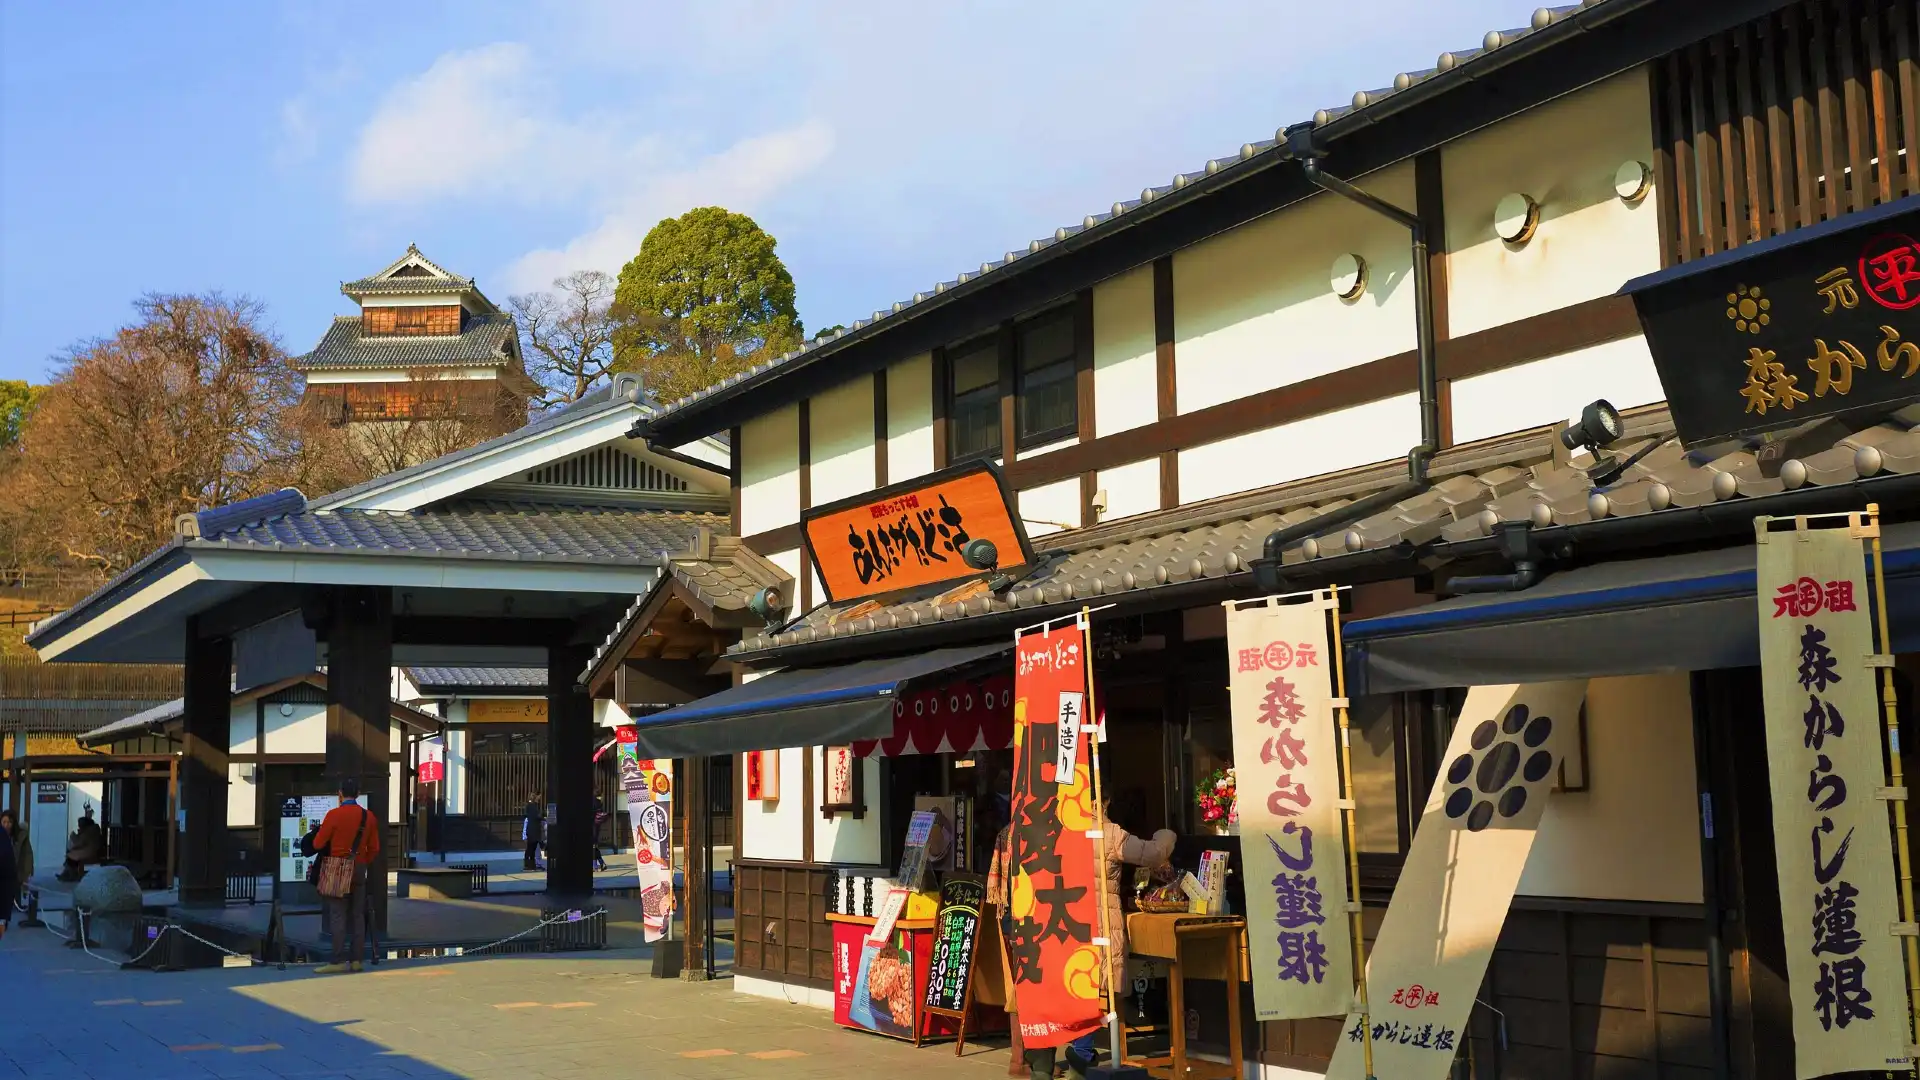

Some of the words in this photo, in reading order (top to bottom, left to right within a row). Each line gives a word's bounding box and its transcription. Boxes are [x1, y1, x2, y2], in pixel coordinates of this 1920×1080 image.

[1740, 325, 1920, 415] 森から
[1060, 700, 1077, 776] 手造り
[1797, 624, 1876, 1033] 森からし蓮根
